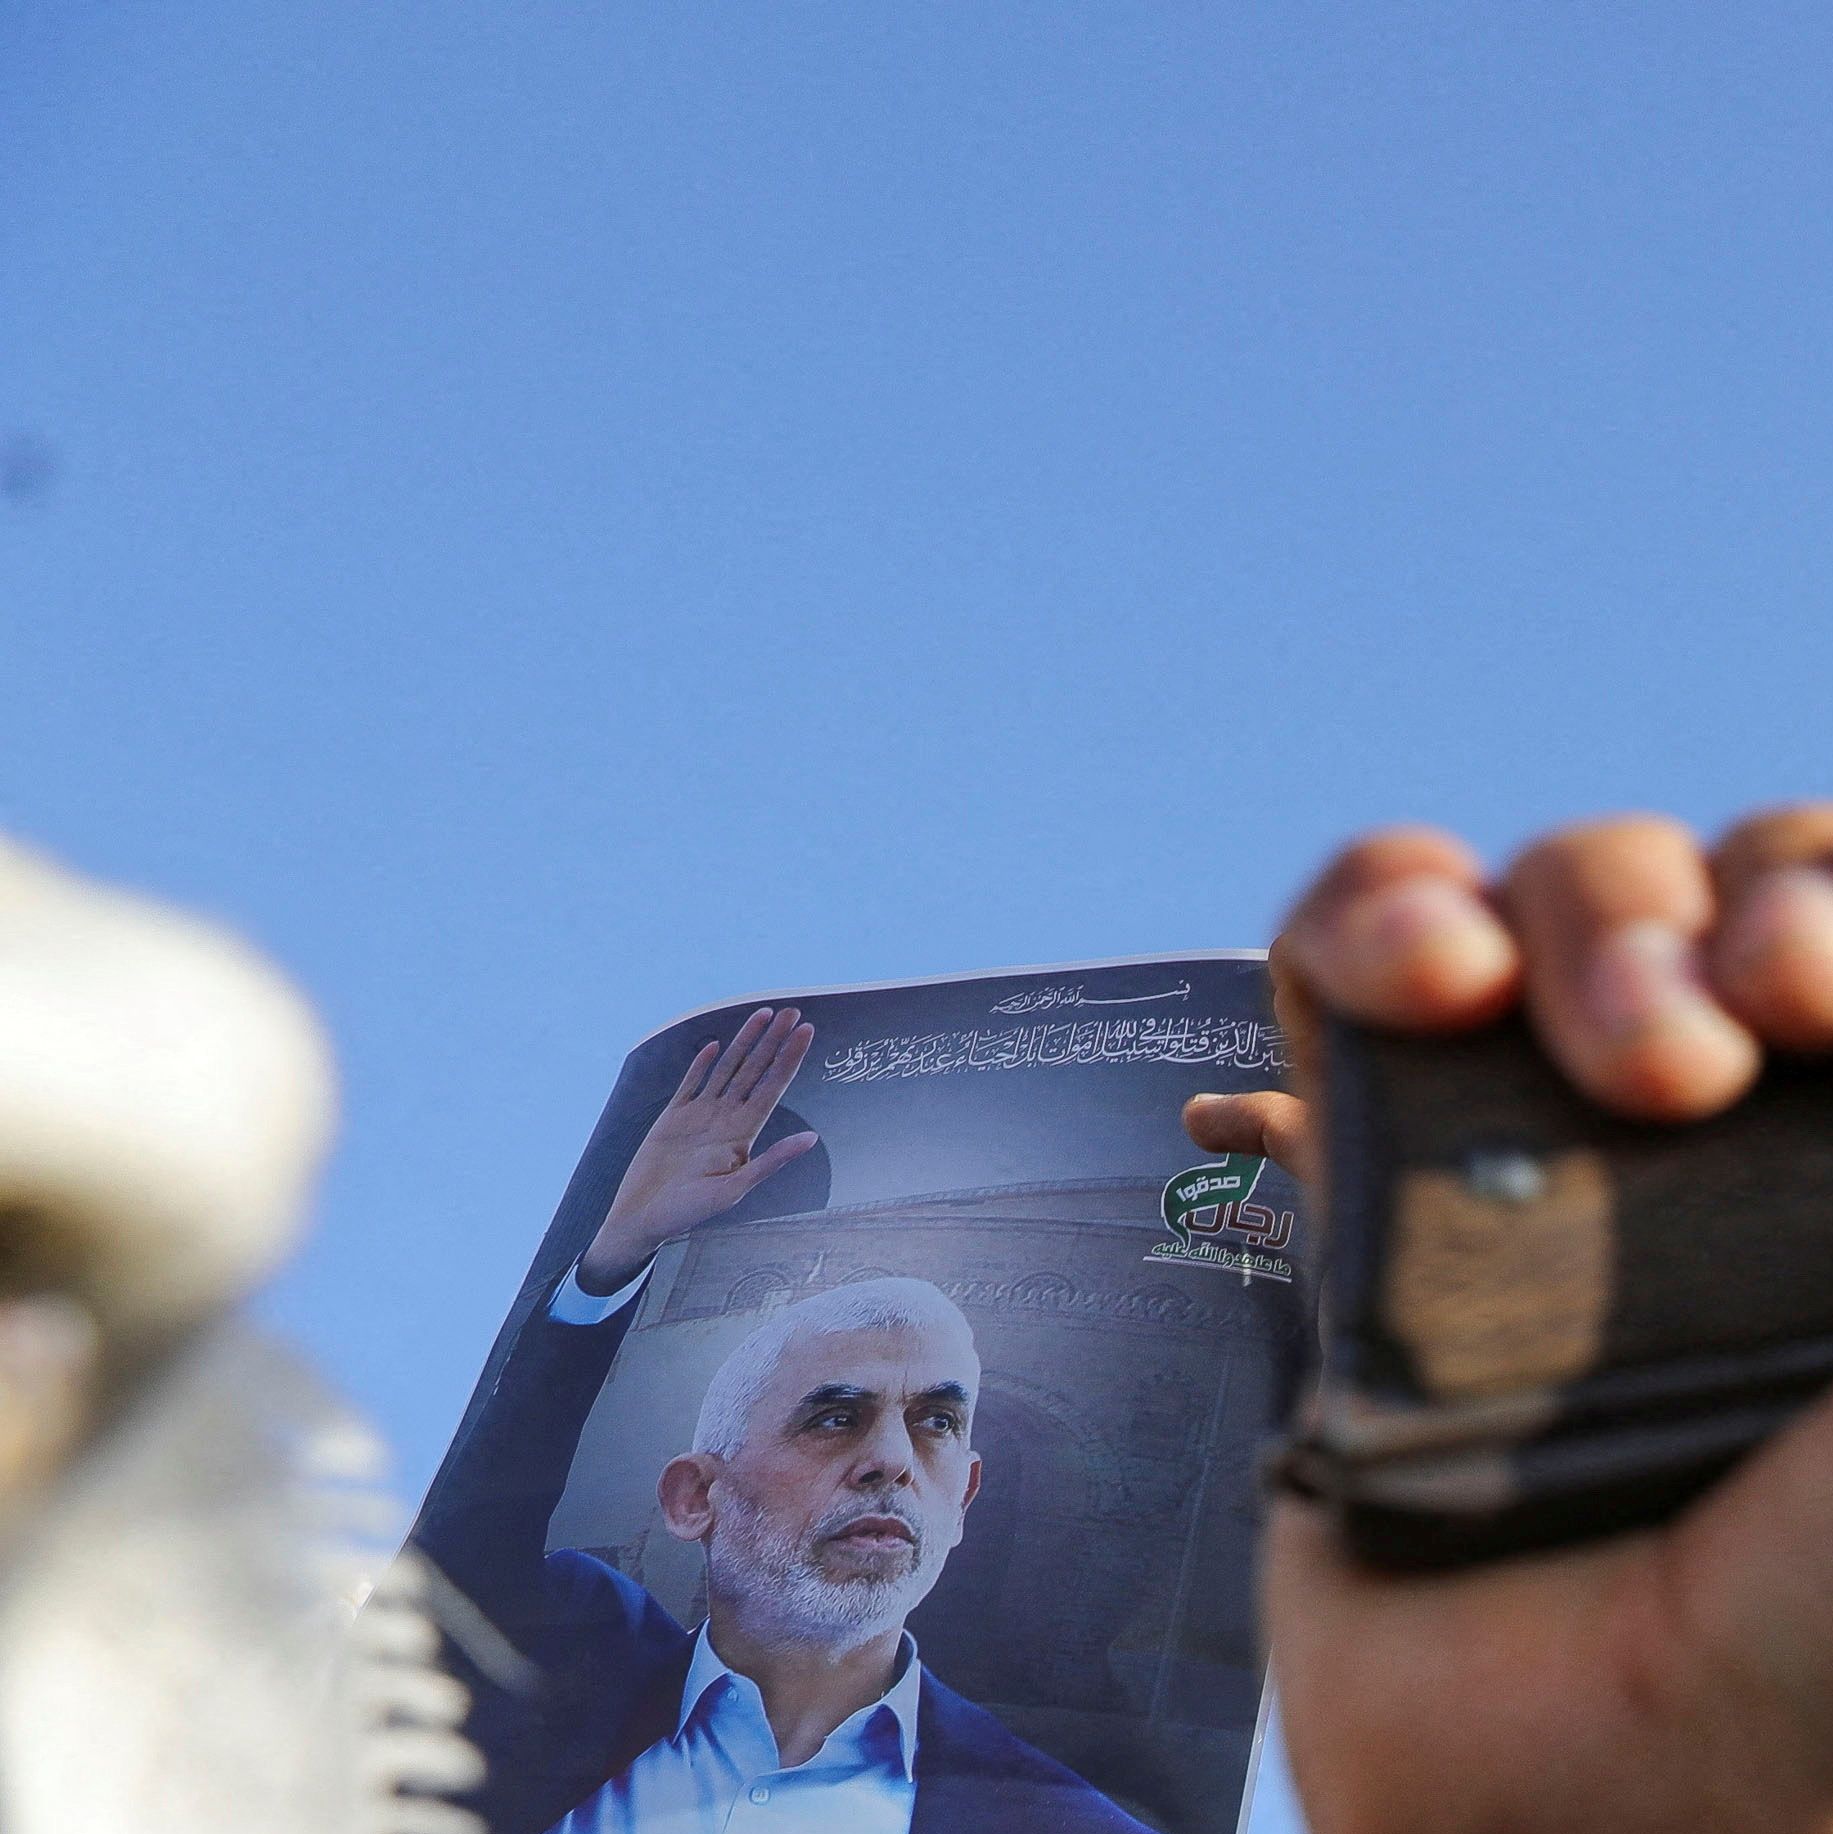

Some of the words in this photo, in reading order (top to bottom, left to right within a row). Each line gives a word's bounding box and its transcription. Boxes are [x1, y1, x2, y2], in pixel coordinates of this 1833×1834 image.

[1059, 984, 1085, 1008] الله
[1176, 1175, 1241, 1203] صدقوا
[1183, 1199, 1295, 1250] رجال
[1188, 1241, 1220, 1263] الله
[1272, 1258, 1292, 1277] ما
